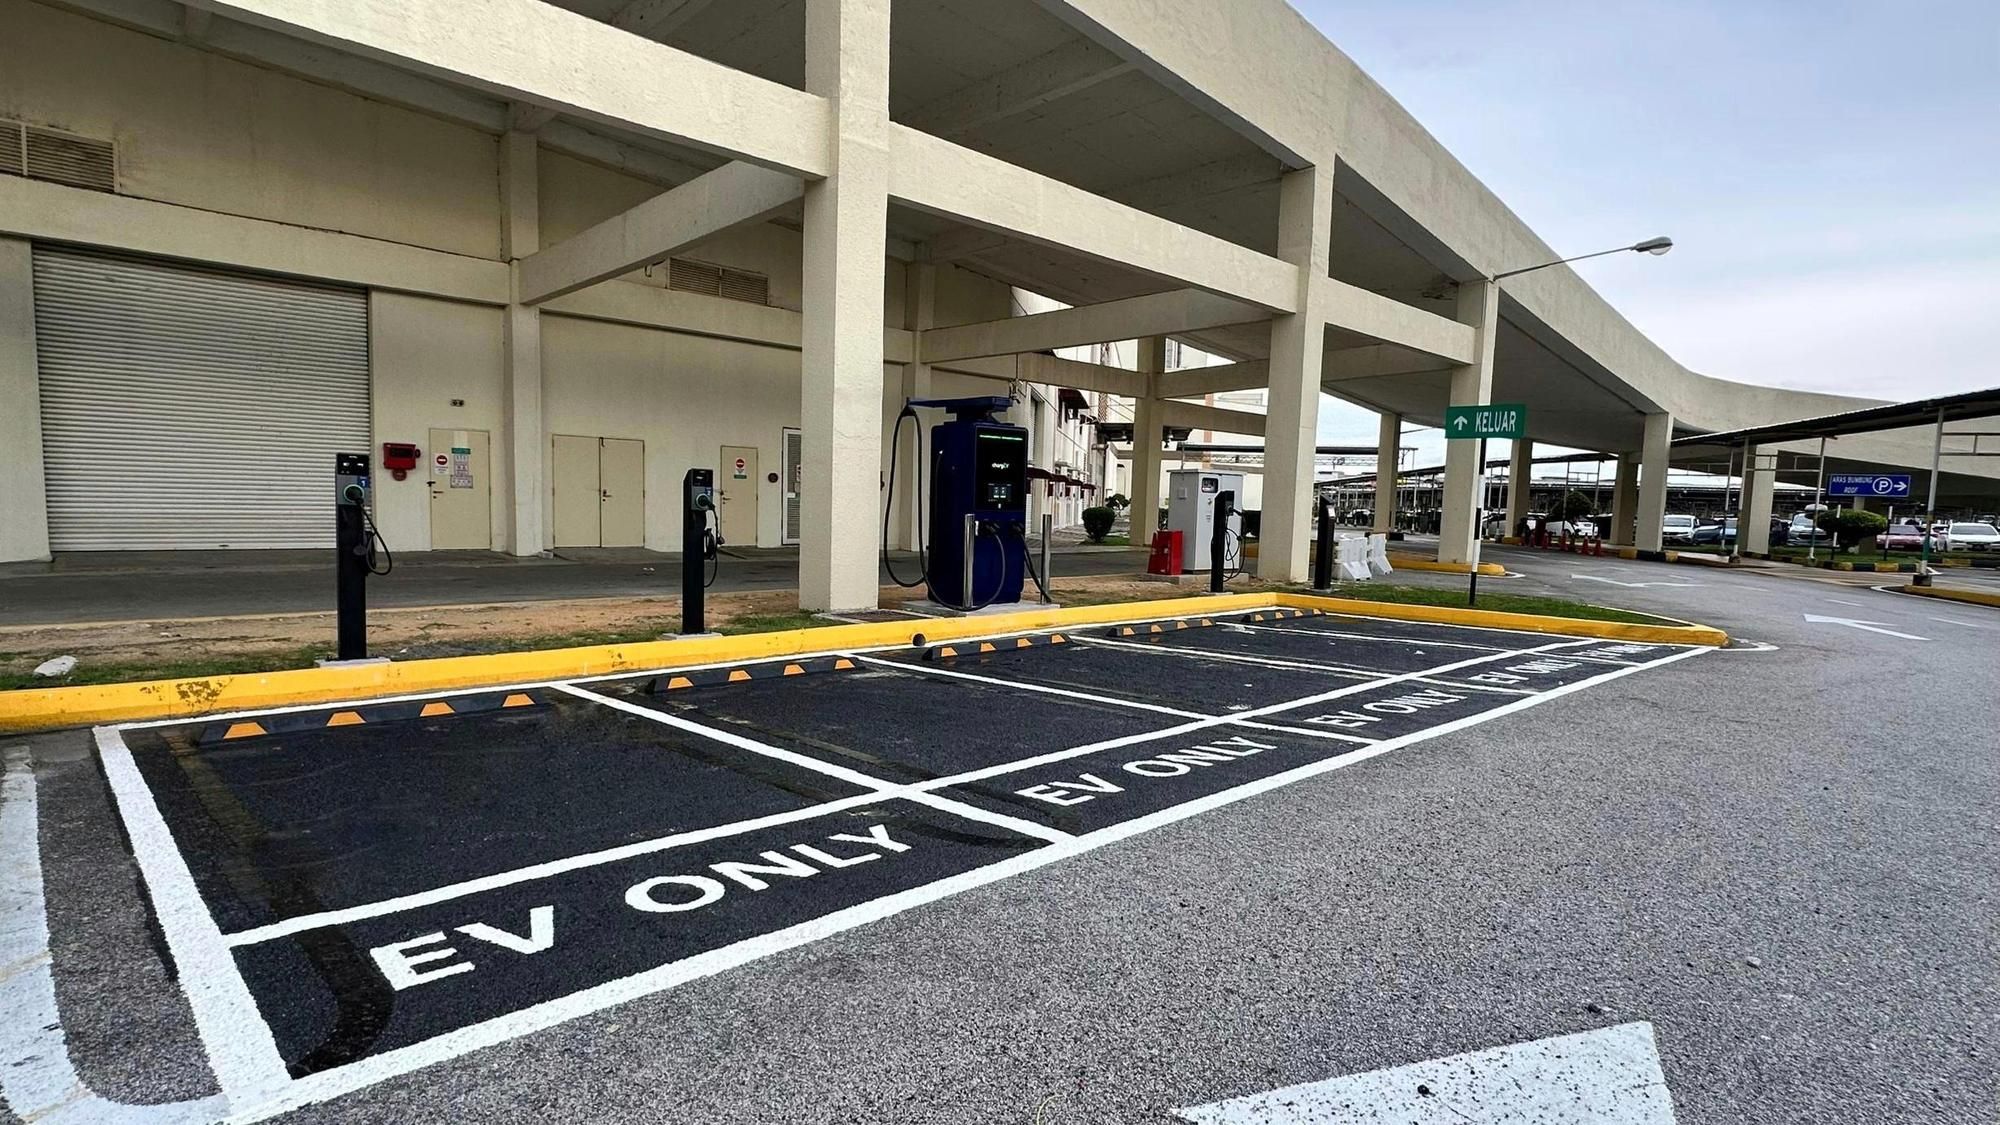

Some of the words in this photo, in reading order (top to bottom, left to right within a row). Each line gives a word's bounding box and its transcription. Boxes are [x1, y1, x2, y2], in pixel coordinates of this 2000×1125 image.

[1475, 410, 1517, 432] KELUAR
[1468, 671, 1529, 685] EV
[1304, 710, 1382, 728] EV
[1363, 689, 1468, 714] ONLY
[1014, 773, 1125, 806] EV
[1123, 736, 1277, 777] ONLY
[370, 905, 554, 990] EV
[625, 824, 911, 912] ONLY
